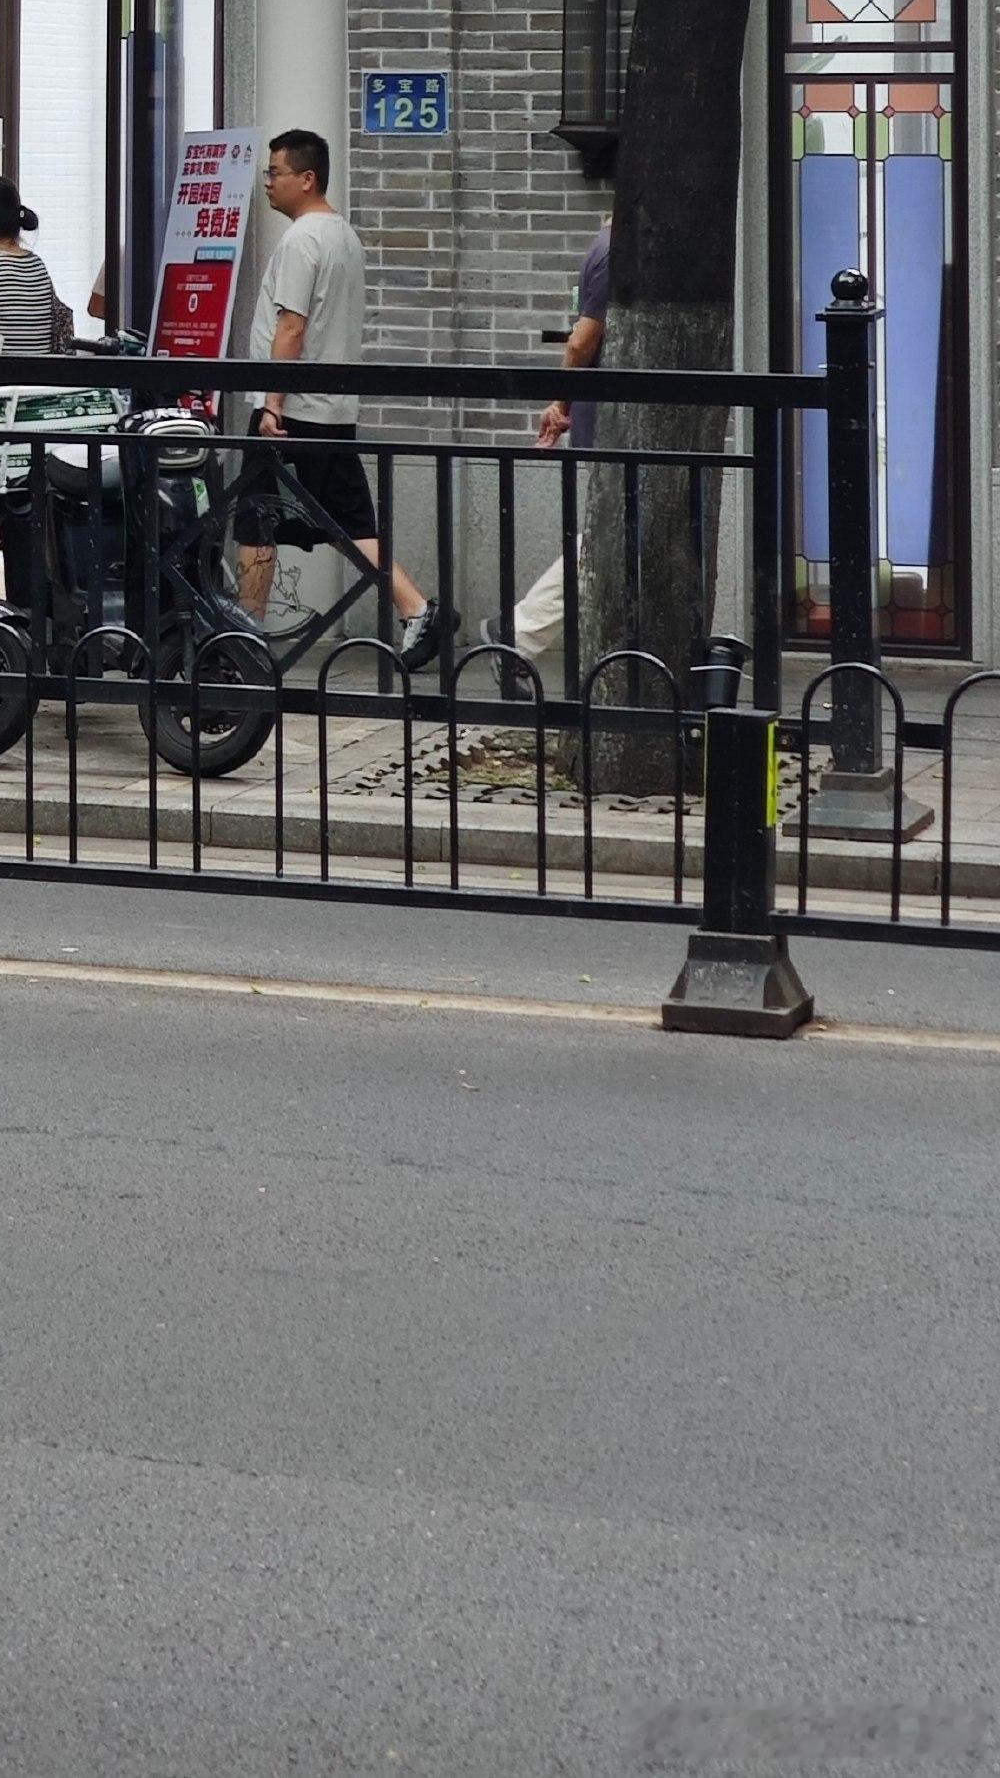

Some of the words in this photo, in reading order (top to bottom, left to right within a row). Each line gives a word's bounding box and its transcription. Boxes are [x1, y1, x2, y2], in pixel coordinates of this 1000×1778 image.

[371, 78, 441, 94] 多宝路
[373, 97, 439, 129] 125
[194, 206, 241, 238] 免费送
